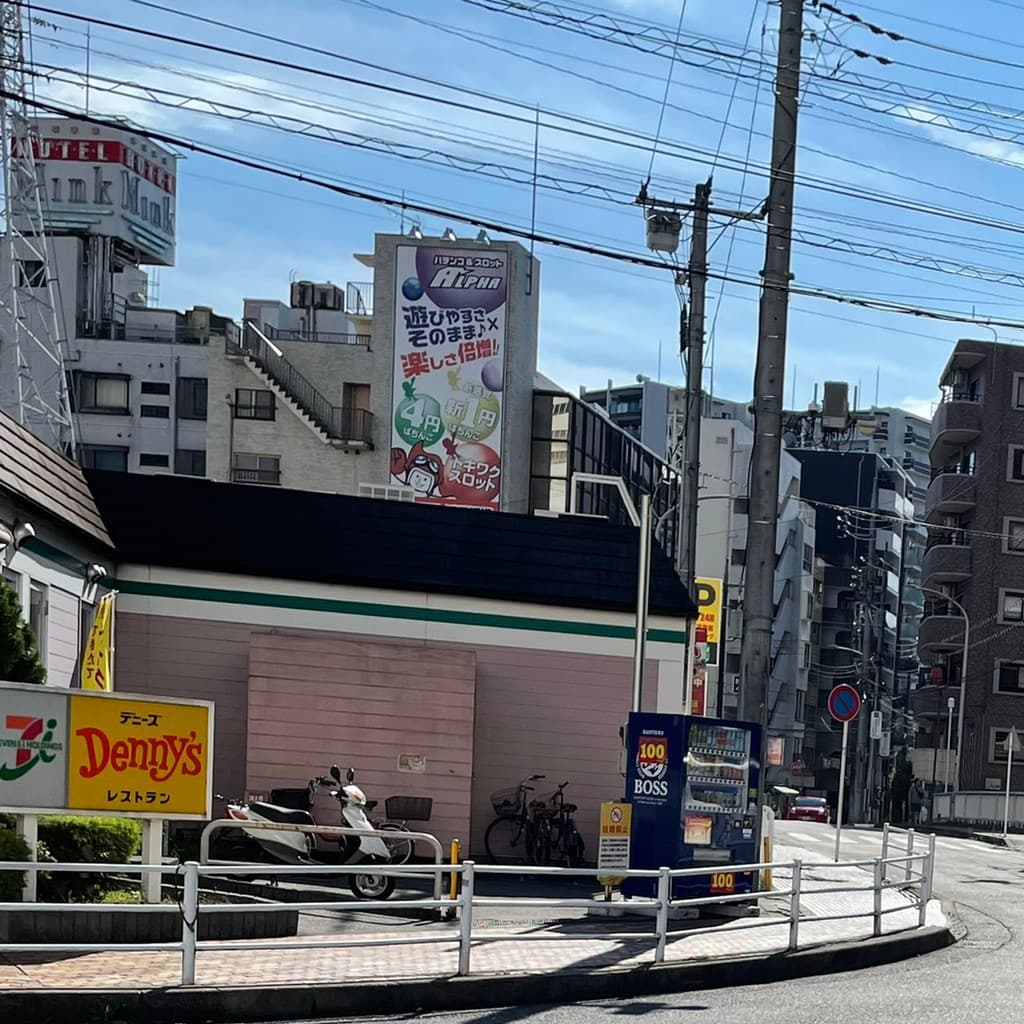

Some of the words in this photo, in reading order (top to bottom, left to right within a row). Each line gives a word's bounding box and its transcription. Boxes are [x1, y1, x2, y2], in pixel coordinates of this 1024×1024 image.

[402, 306, 485, 329] 遊びやすさ
[401, 399, 441, 433] 4円
[449, 470, 496, 492] スロット
[119, 711, 163, 728] デニーズ
[76, 728, 202, 782] Denny's
[640, 743, 665, 760] 100
[634, 779, 668, 796] BOSS
[107, 790, 170, 805] レストラン
[712, 873, 734, 888] 100
